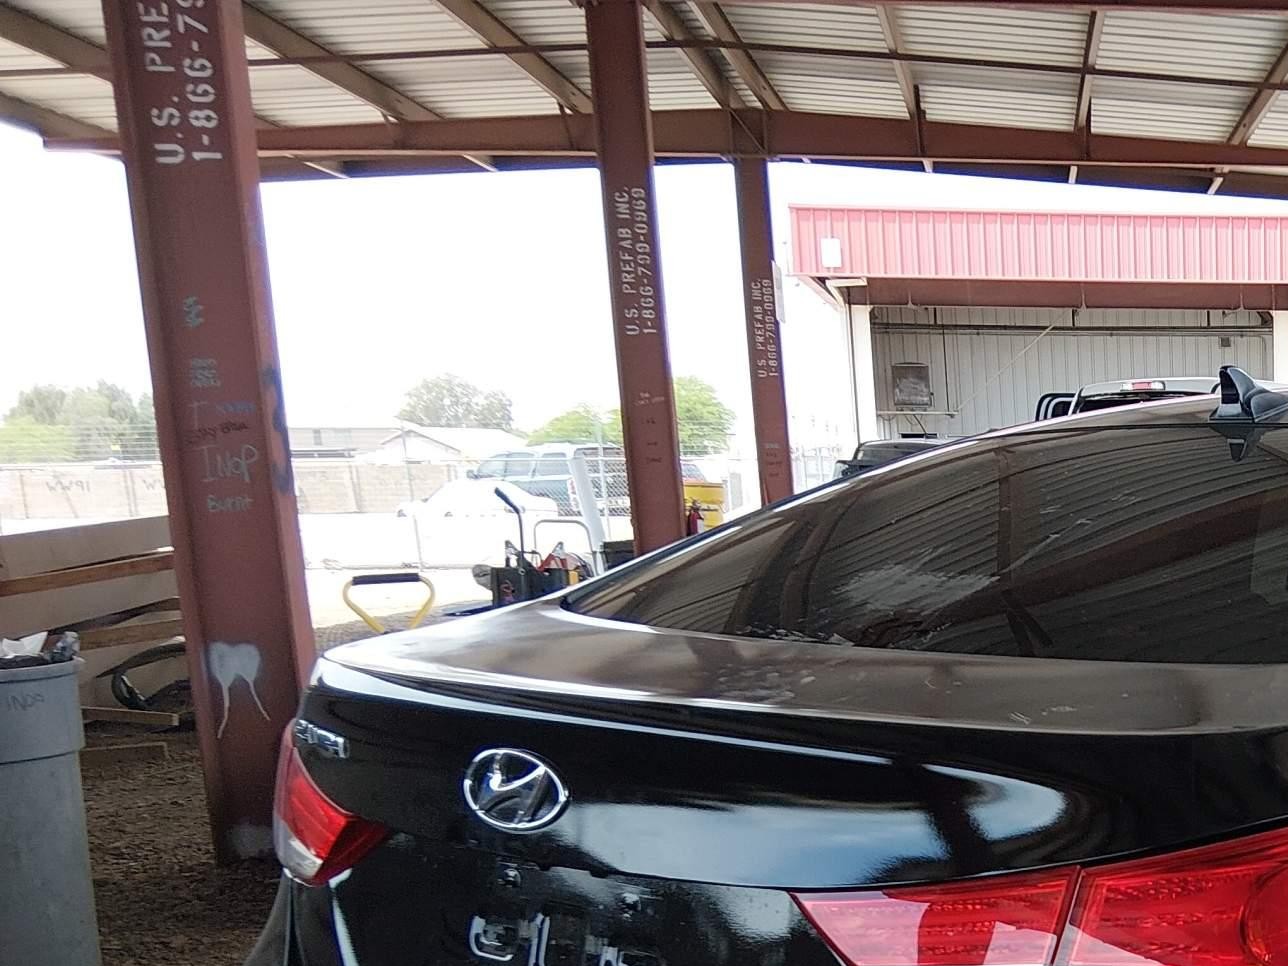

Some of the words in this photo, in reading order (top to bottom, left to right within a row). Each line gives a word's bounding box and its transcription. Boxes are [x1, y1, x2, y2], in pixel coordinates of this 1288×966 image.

[150, 96, 186, 164] U.S.
[614, 186, 632, 219] INC.
[618, 227, 637, 294] PREFAB
[624, 302, 641, 335] U.S.
[753, 305, 766, 350] PREFAB
